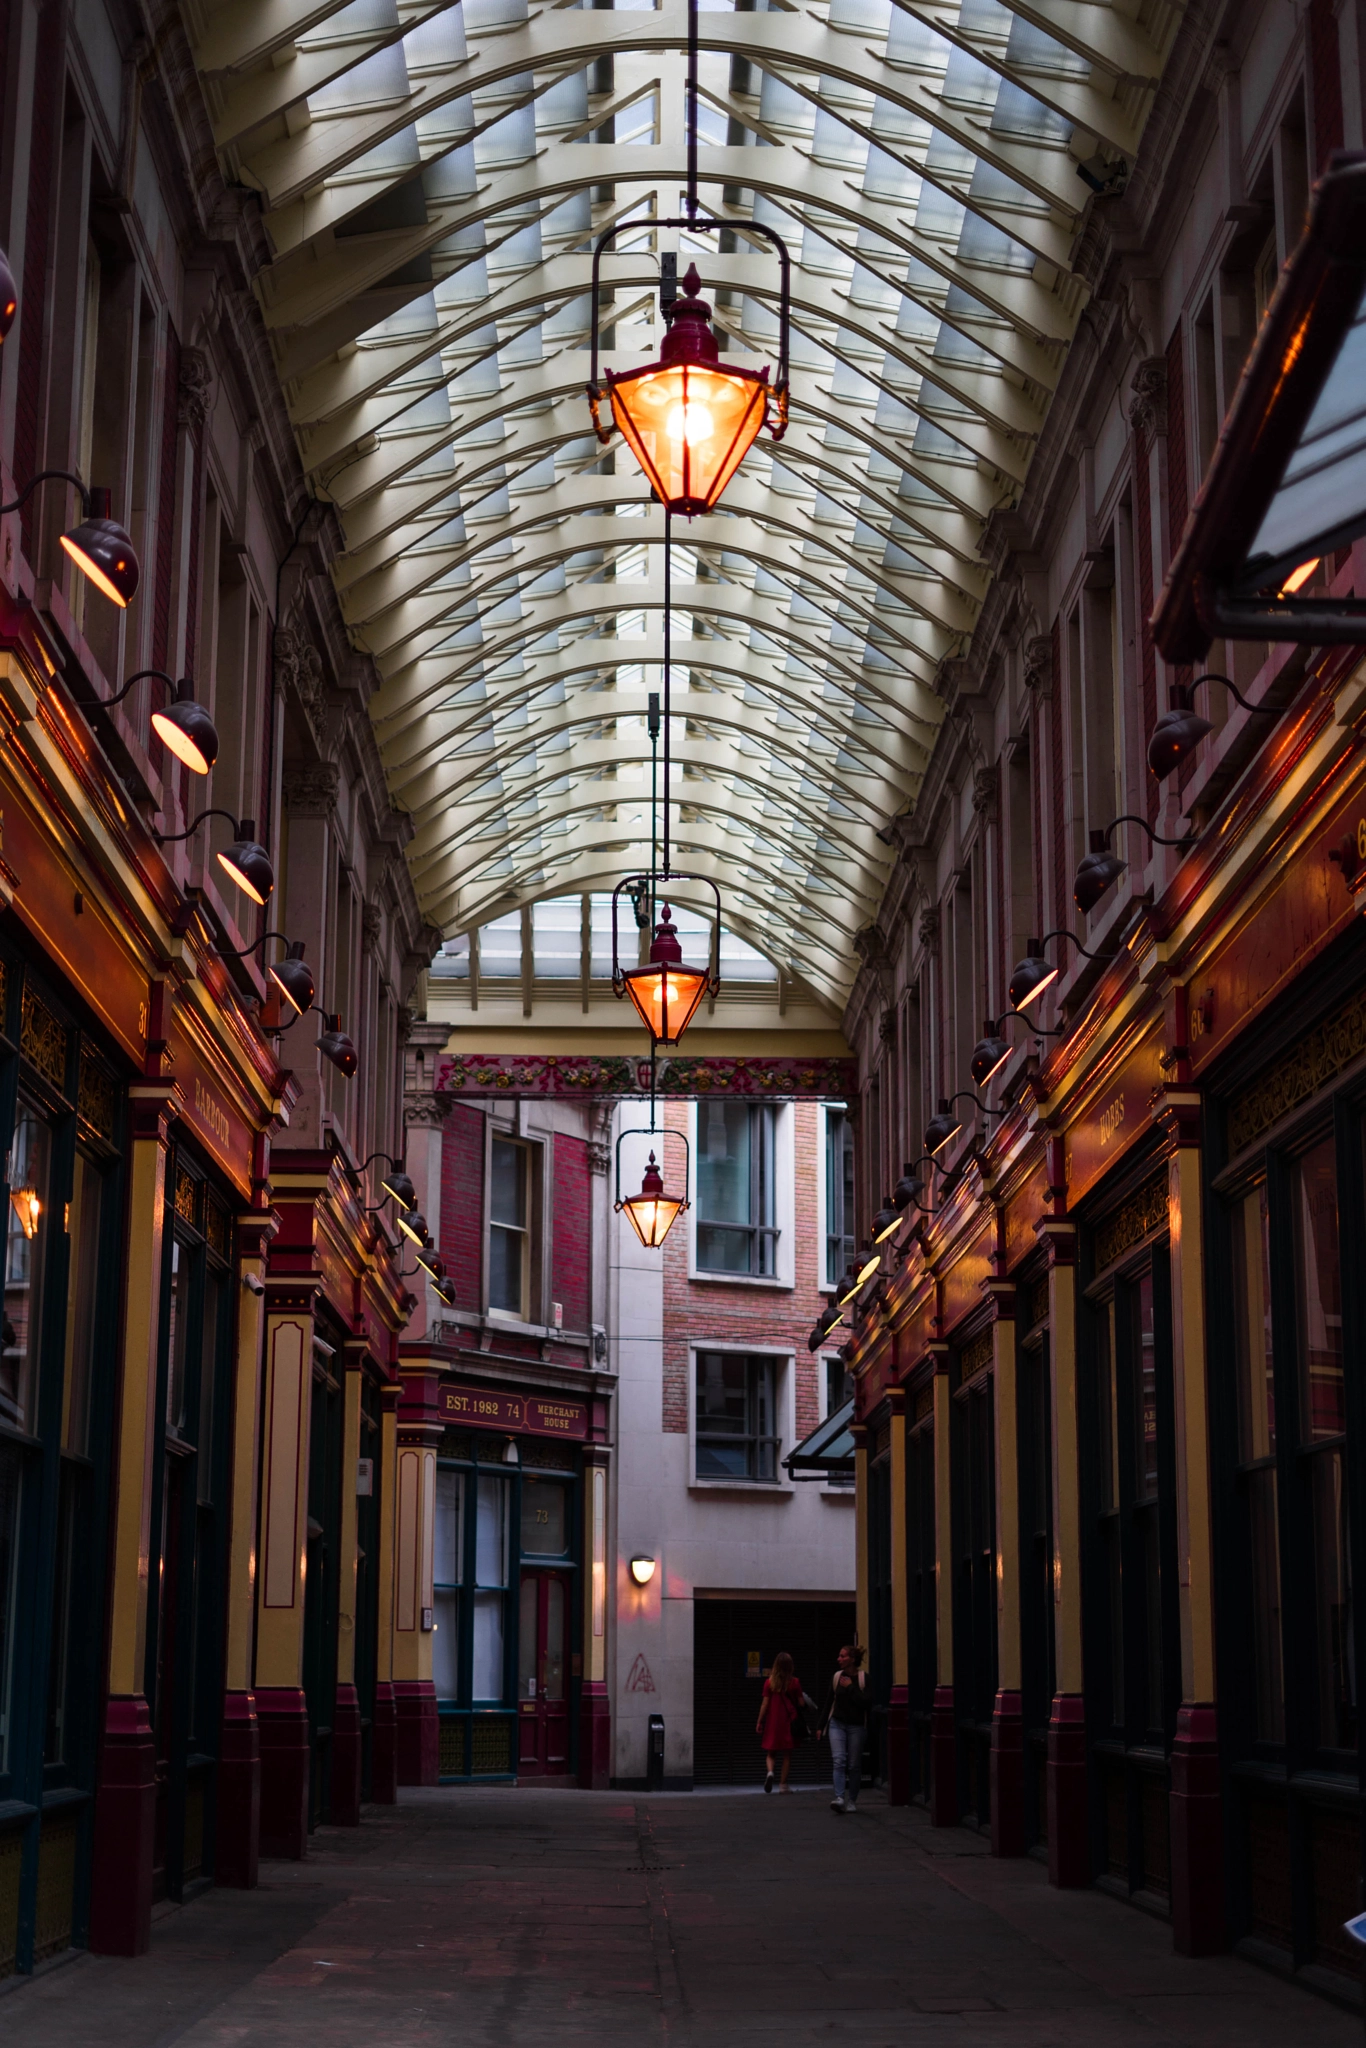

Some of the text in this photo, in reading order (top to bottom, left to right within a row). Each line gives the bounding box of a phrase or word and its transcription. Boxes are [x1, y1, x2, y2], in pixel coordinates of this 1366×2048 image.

[194, 1077, 230, 1149] BARBOUR
[1099, 1092, 1126, 1147] HOBBS
[446, 1395, 520, 1418] EST. 1982 74
[537, 1404, 580, 1419] MERCHANT
[544, 1417, 570, 1429] HOUSE
[536, 1509, 549, 1524] 73
